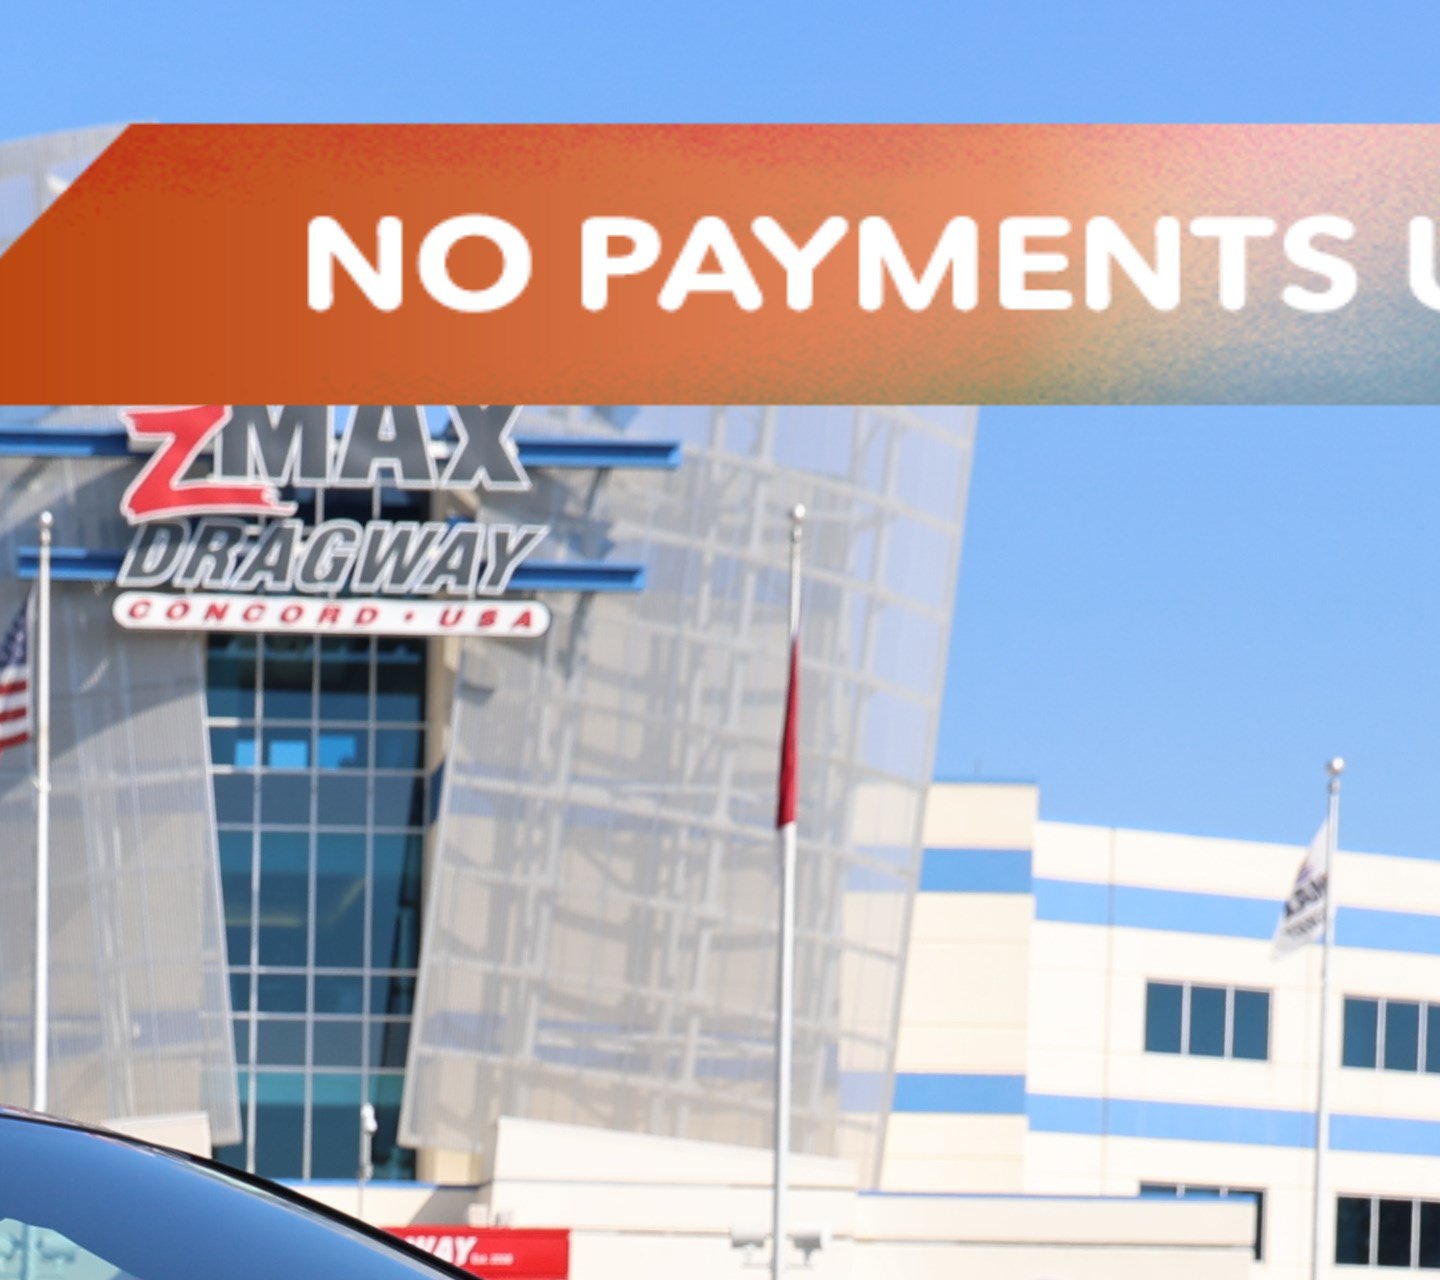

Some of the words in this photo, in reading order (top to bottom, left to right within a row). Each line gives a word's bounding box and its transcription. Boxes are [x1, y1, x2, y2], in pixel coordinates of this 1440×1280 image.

[118, 516, 551, 595] DRAGWAY
[128, 600, 380, 628] CONCORD
[439, 606, 534, 631] USA
[404, 1235, 477, 1267] WAY
